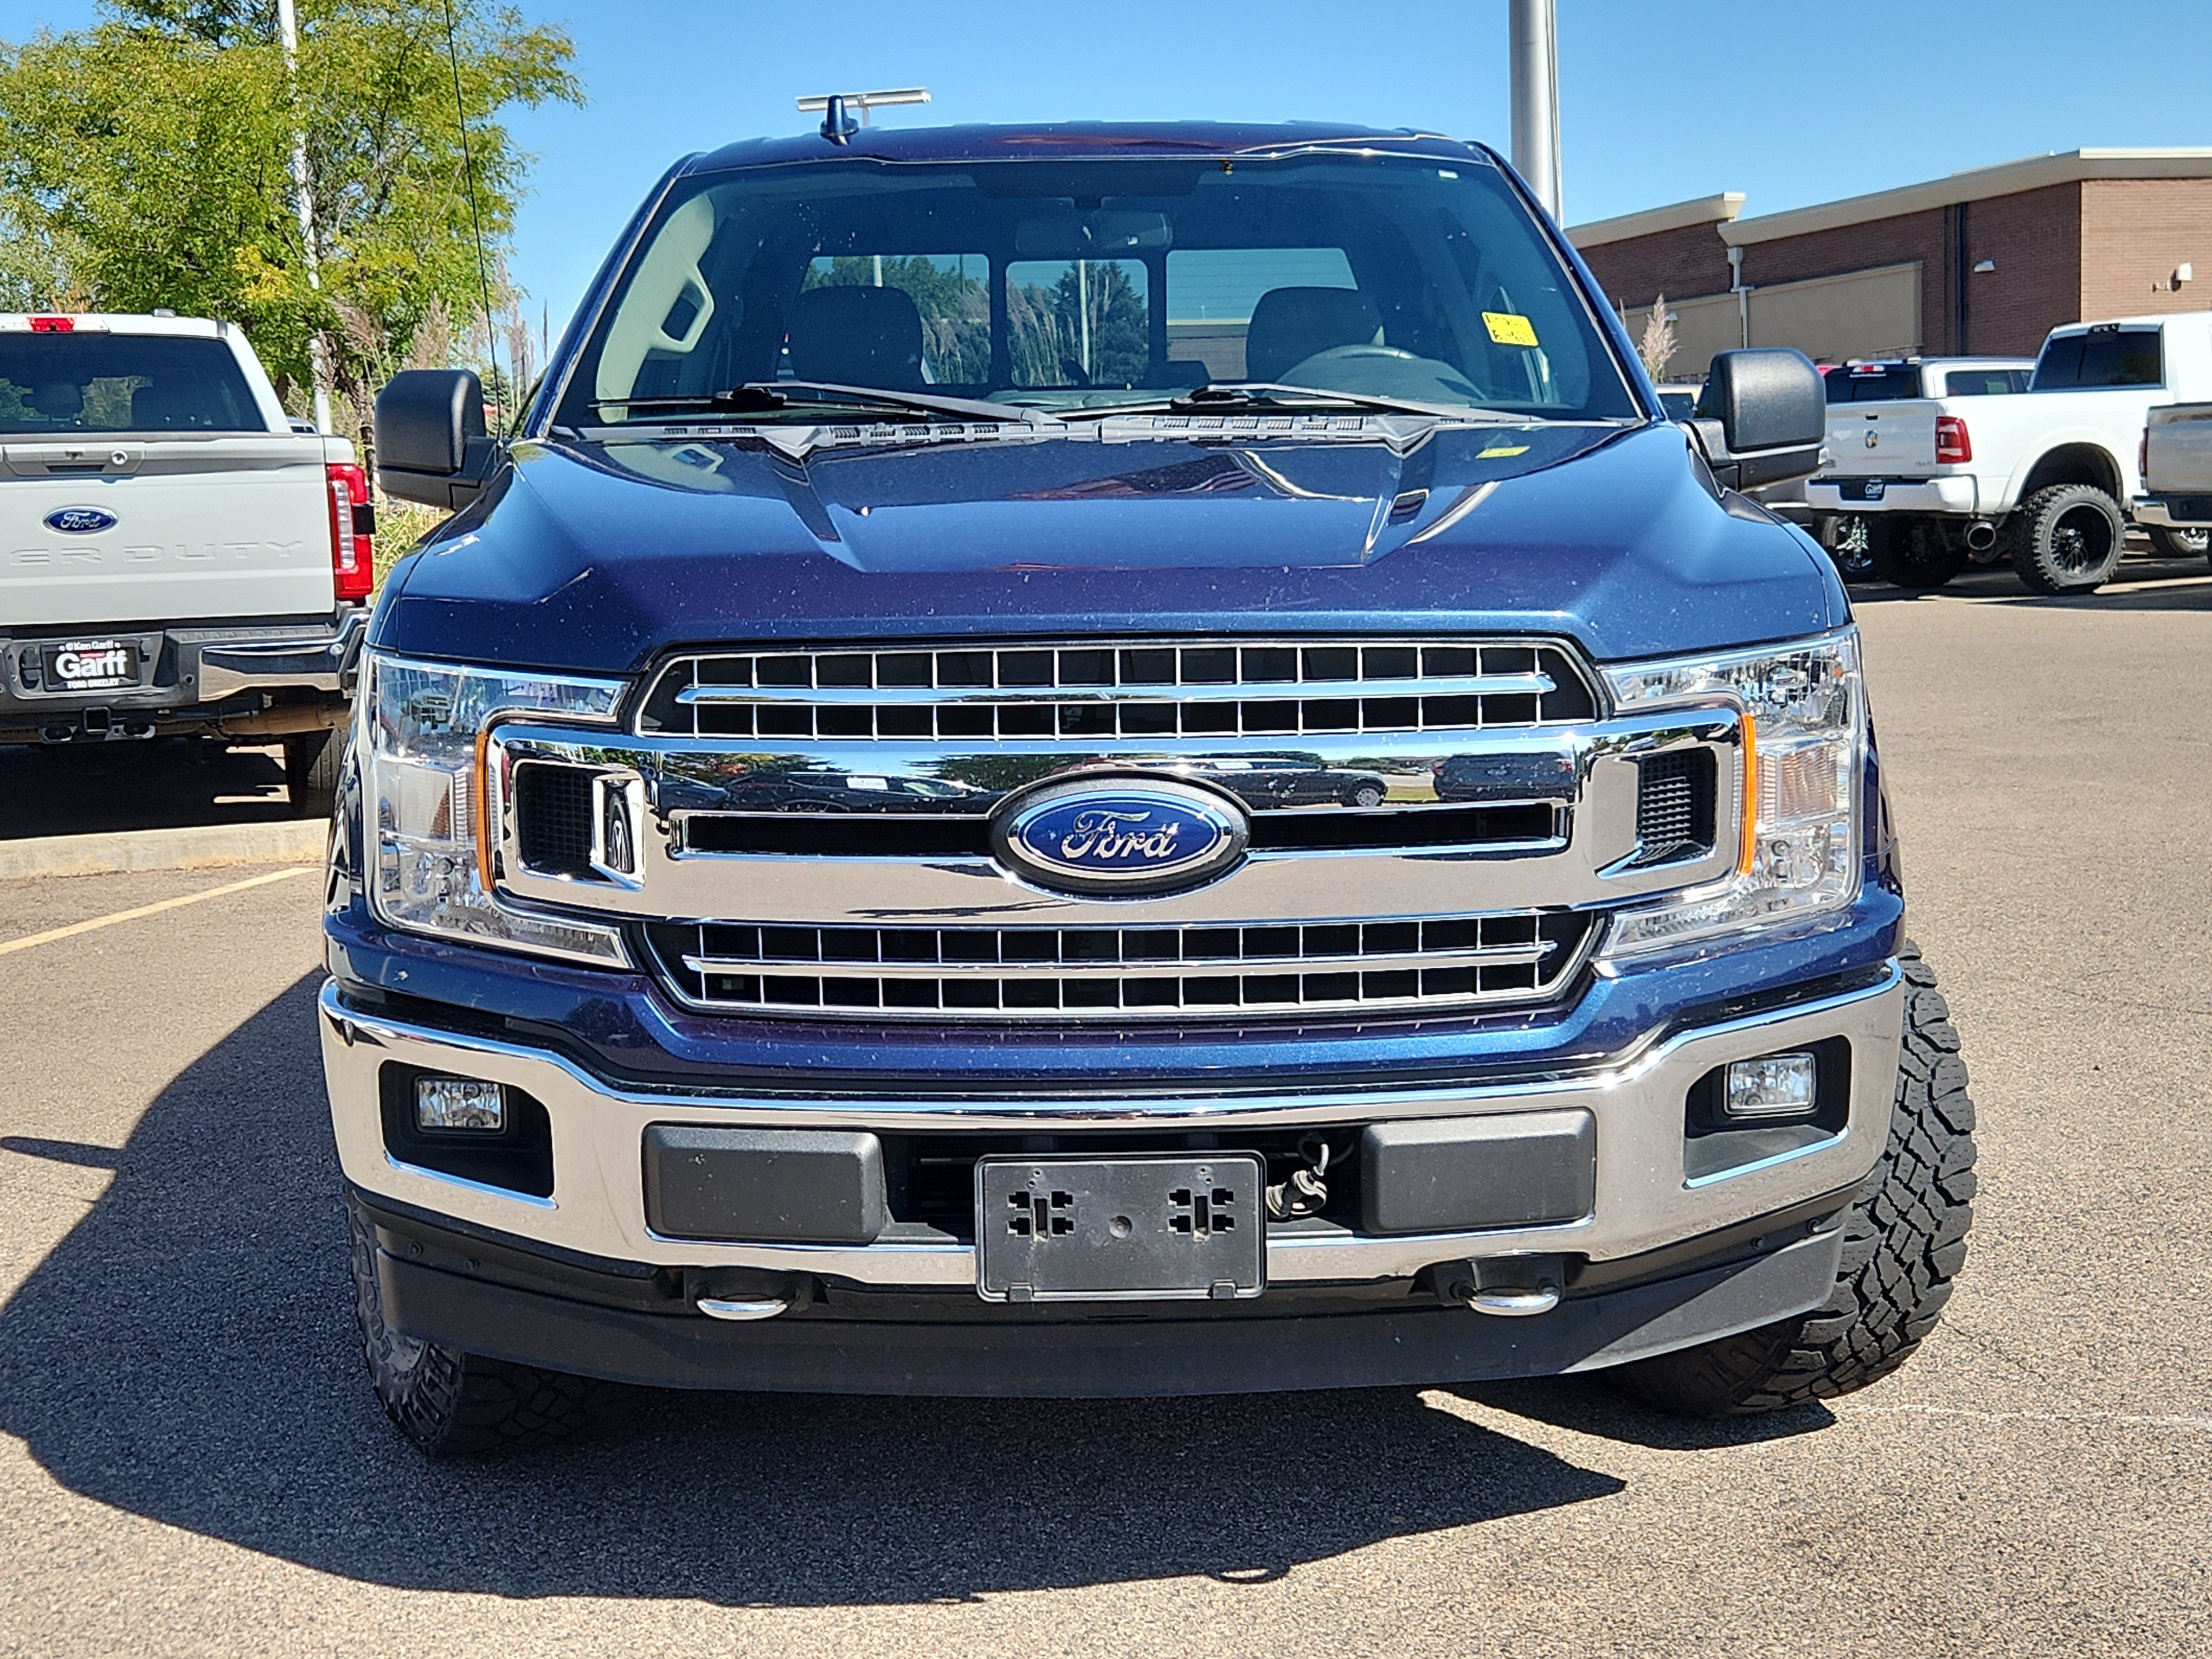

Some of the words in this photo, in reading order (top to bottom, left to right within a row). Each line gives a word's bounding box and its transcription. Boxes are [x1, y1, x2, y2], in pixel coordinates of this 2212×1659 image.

[60, 512, 101, 529] Ford
[124, 541, 303, 563] DUTY
[56, 650, 127, 678] Garff
[1062, 811, 1179, 859] Ford
